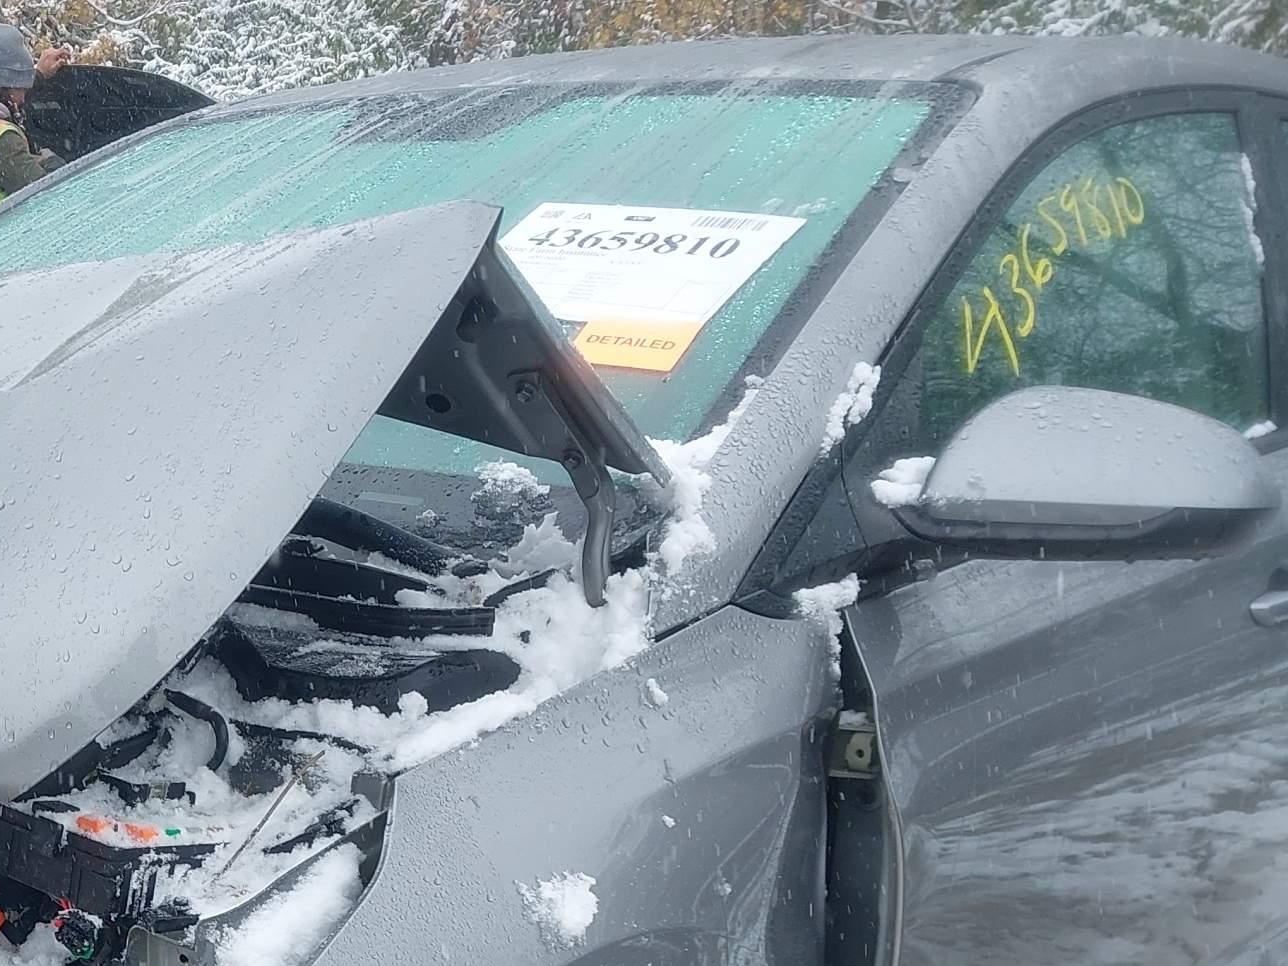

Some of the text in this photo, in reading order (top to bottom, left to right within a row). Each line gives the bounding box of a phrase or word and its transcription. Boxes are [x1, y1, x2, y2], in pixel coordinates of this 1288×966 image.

[527, 226, 741, 259] 43659810
[962, 177, 1144, 377] 43659810
[585, 333, 677, 351] DETAILED
